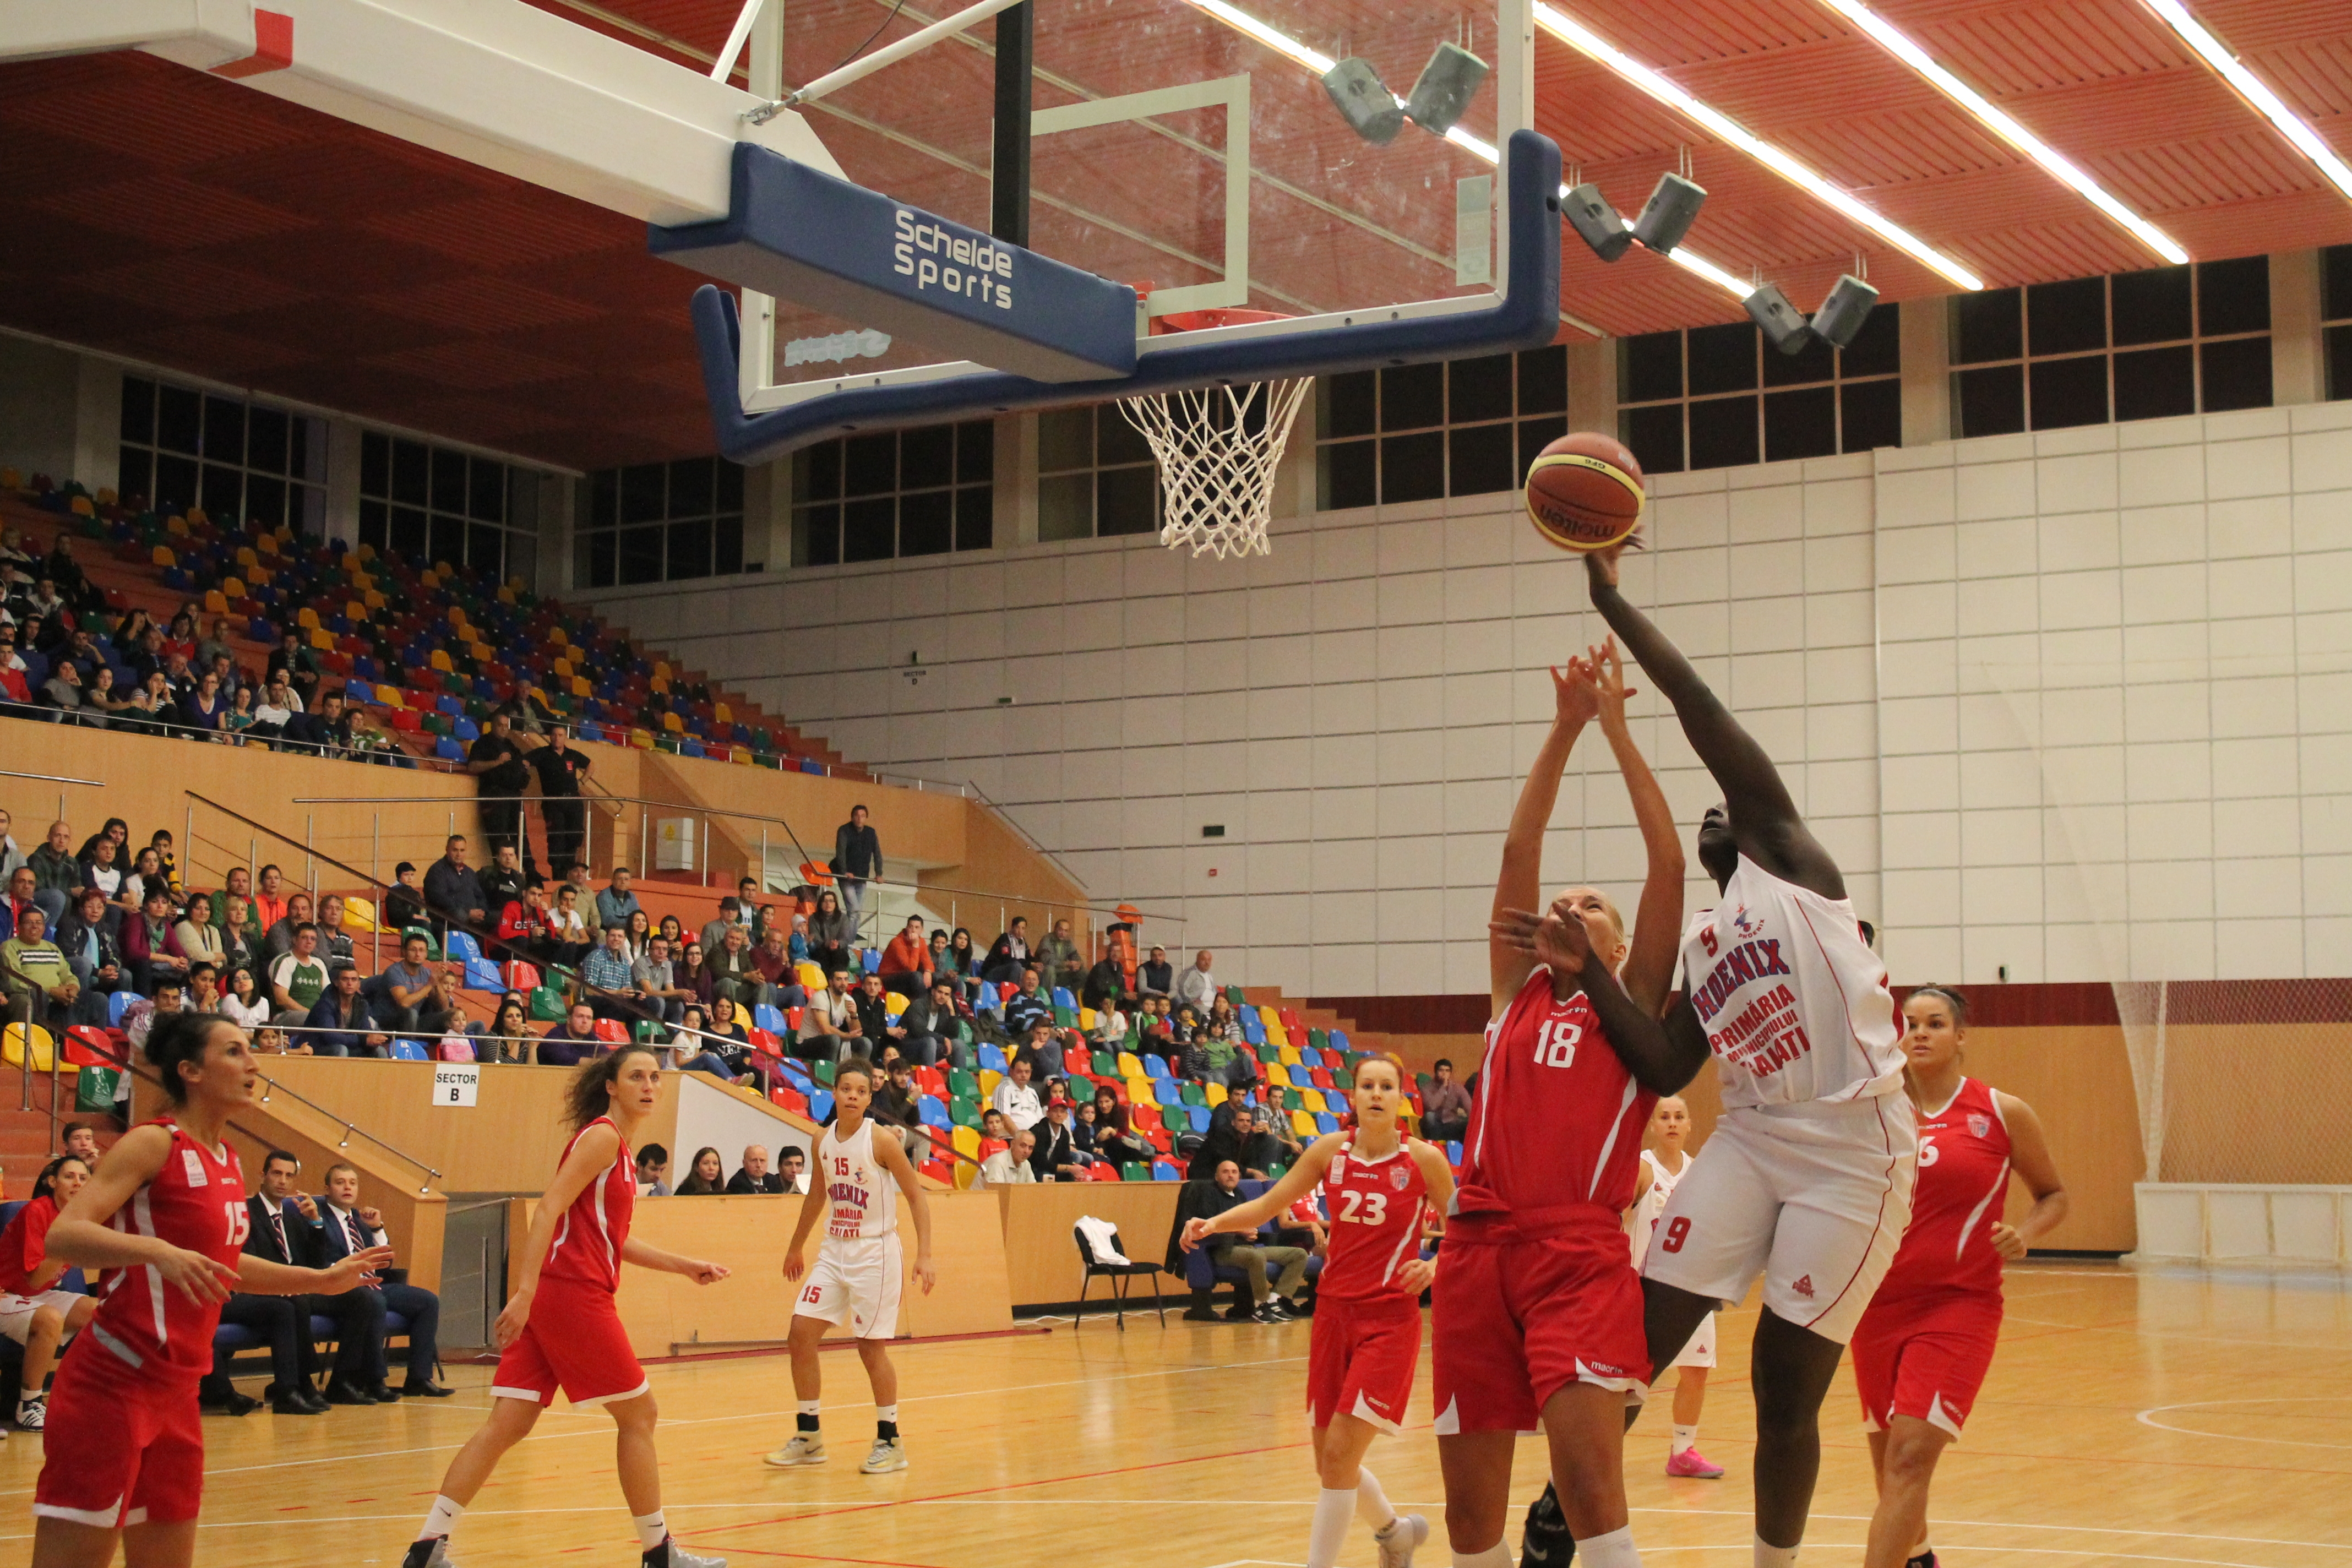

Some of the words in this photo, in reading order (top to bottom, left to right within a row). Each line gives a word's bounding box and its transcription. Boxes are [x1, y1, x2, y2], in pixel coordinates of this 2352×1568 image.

[895, 210, 1012, 279] Schelde
[894, 243, 1012, 309] Sports
[1540, 504, 1616, 537] molten
[1738, 919, 1765, 939] PHOENIX
[1691, 939, 1791, 1024] HOENIX
[1533, 1020, 1582, 1068] 18
[435, 1073, 477, 1085] SECTOR
[450, 1088, 459, 1101] B
[835, 1157, 848, 1176] 15
[224, 1201, 250, 1246] 15
[1339, 1190, 1387, 1226] 23
[1662, 1216, 1691, 1254] 9
[802, 1286, 822, 1304] 15
